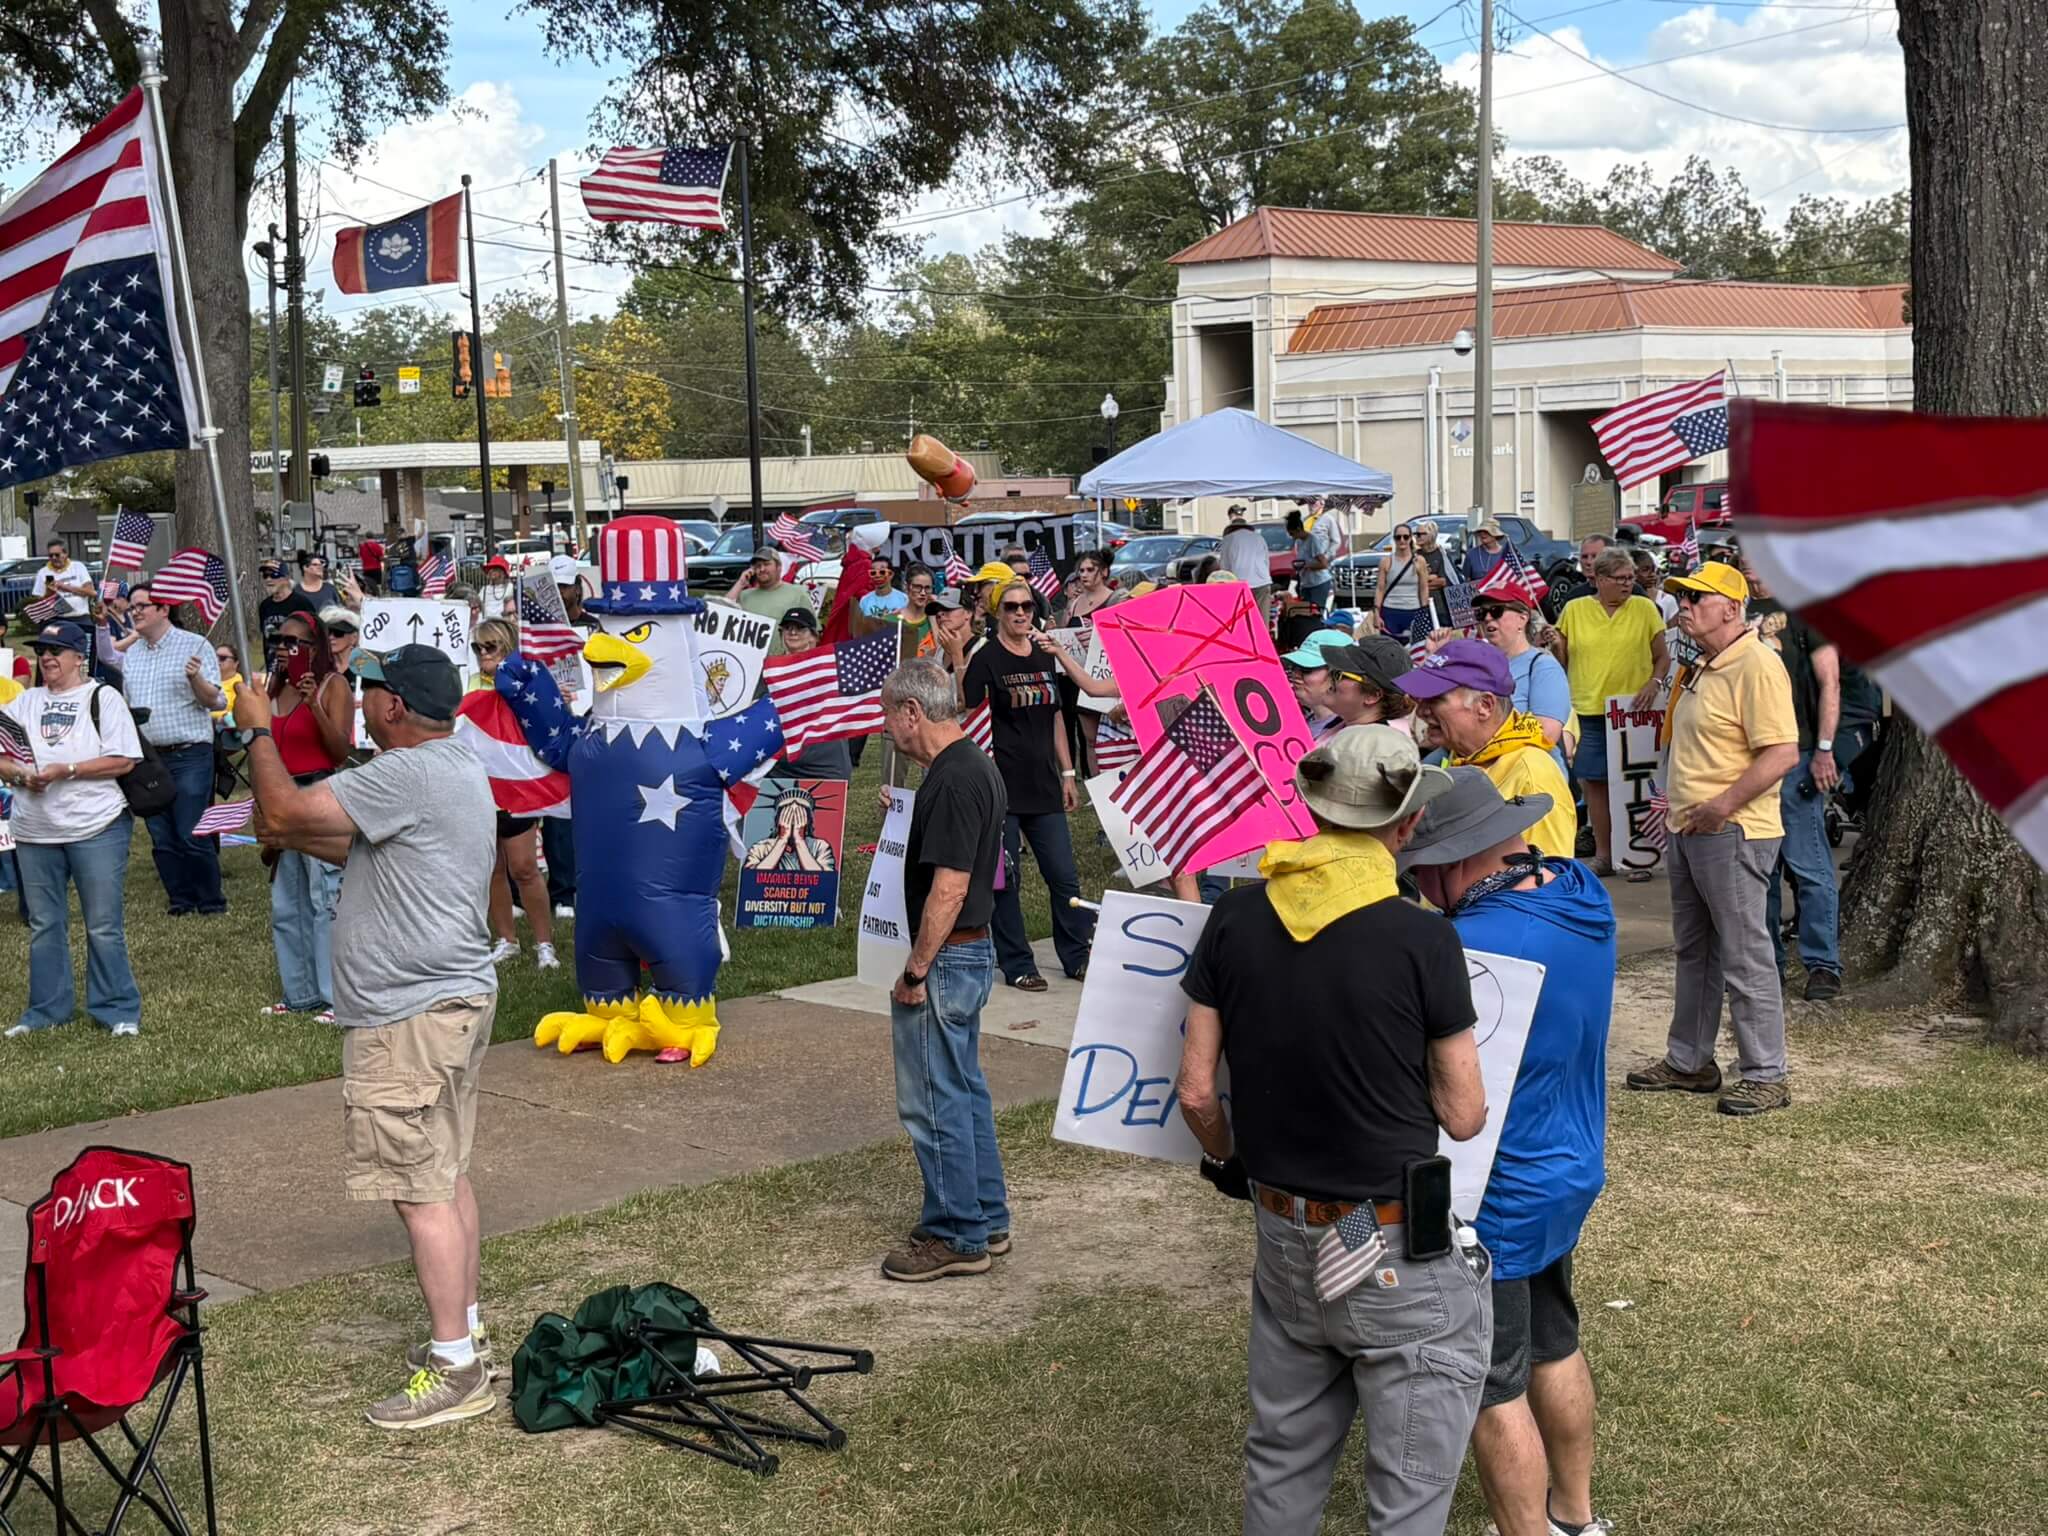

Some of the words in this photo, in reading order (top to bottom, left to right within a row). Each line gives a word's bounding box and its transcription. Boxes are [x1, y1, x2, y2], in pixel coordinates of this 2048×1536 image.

[1450, 442, 1514, 457] Trusark
[363, 611, 390, 640] GOD
[441, 608, 464, 649] JESUS
[1126, 841, 1160, 871] FO
[756, 872, 793, 885] IMAGINE
[793, 873, 820, 886] BEING
[763, 886, 797, 899] SCARED
[798, 887, 810, 899] OF
[867, 881, 881, 898] JUST
[745, 900, 790, 913] DIVERSITY
[790, 901, 807, 914] BUT
[808, 902, 826, 915] NOT
[753, 914, 815, 929] DICTATORSHIP
[863, 914, 899, 938] PATRIOTS
